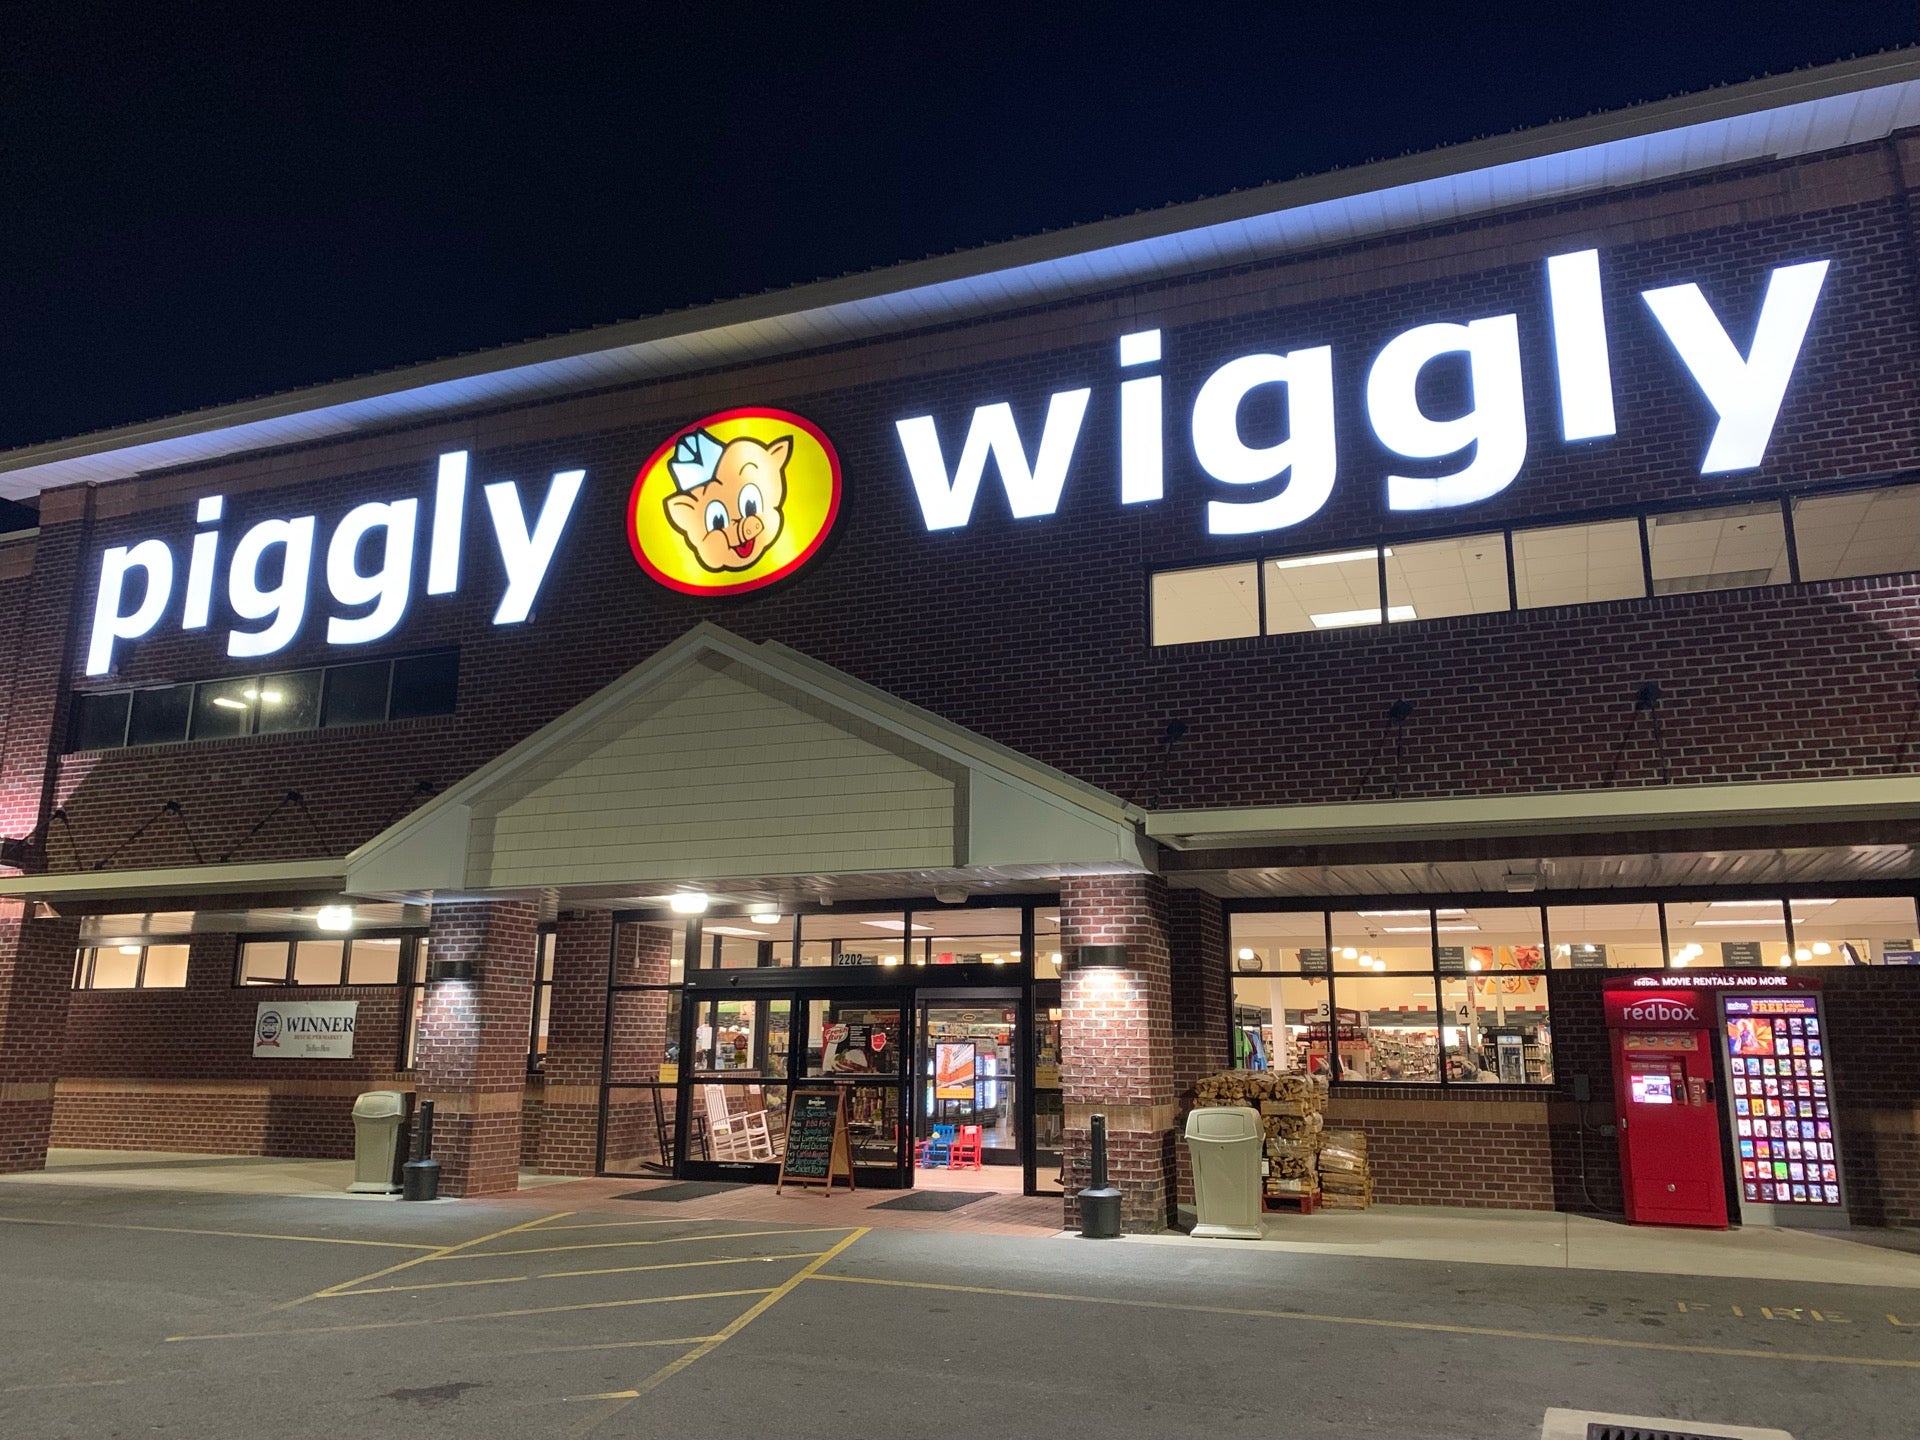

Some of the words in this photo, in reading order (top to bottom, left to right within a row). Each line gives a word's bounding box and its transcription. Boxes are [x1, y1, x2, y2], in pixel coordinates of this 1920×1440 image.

[86, 450, 586, 676] piggly
[895, 248, 1830, 535] wiggly
[839, 953, 862, 965] 2202
[1662, 977, 1691, 986] MOVIE
[1693, 977, 1735, 986] RENTALS
[1736, 977, 1757, 986] AND
[1759, 977, 1788, 986] MORE
[1320, 1003, 1330, 1016] 3
[1459, 1004, 1469, 1017] 4
[1623, 1004, 1695, 1021] redbox
[1751, 1003, 1783, 1012] FREE
[287, 1017, 353, 1032] WINNER
[825, 1027, 848, 1036] Fresh
[1678, 1301, 1851, 1322] FIRE
